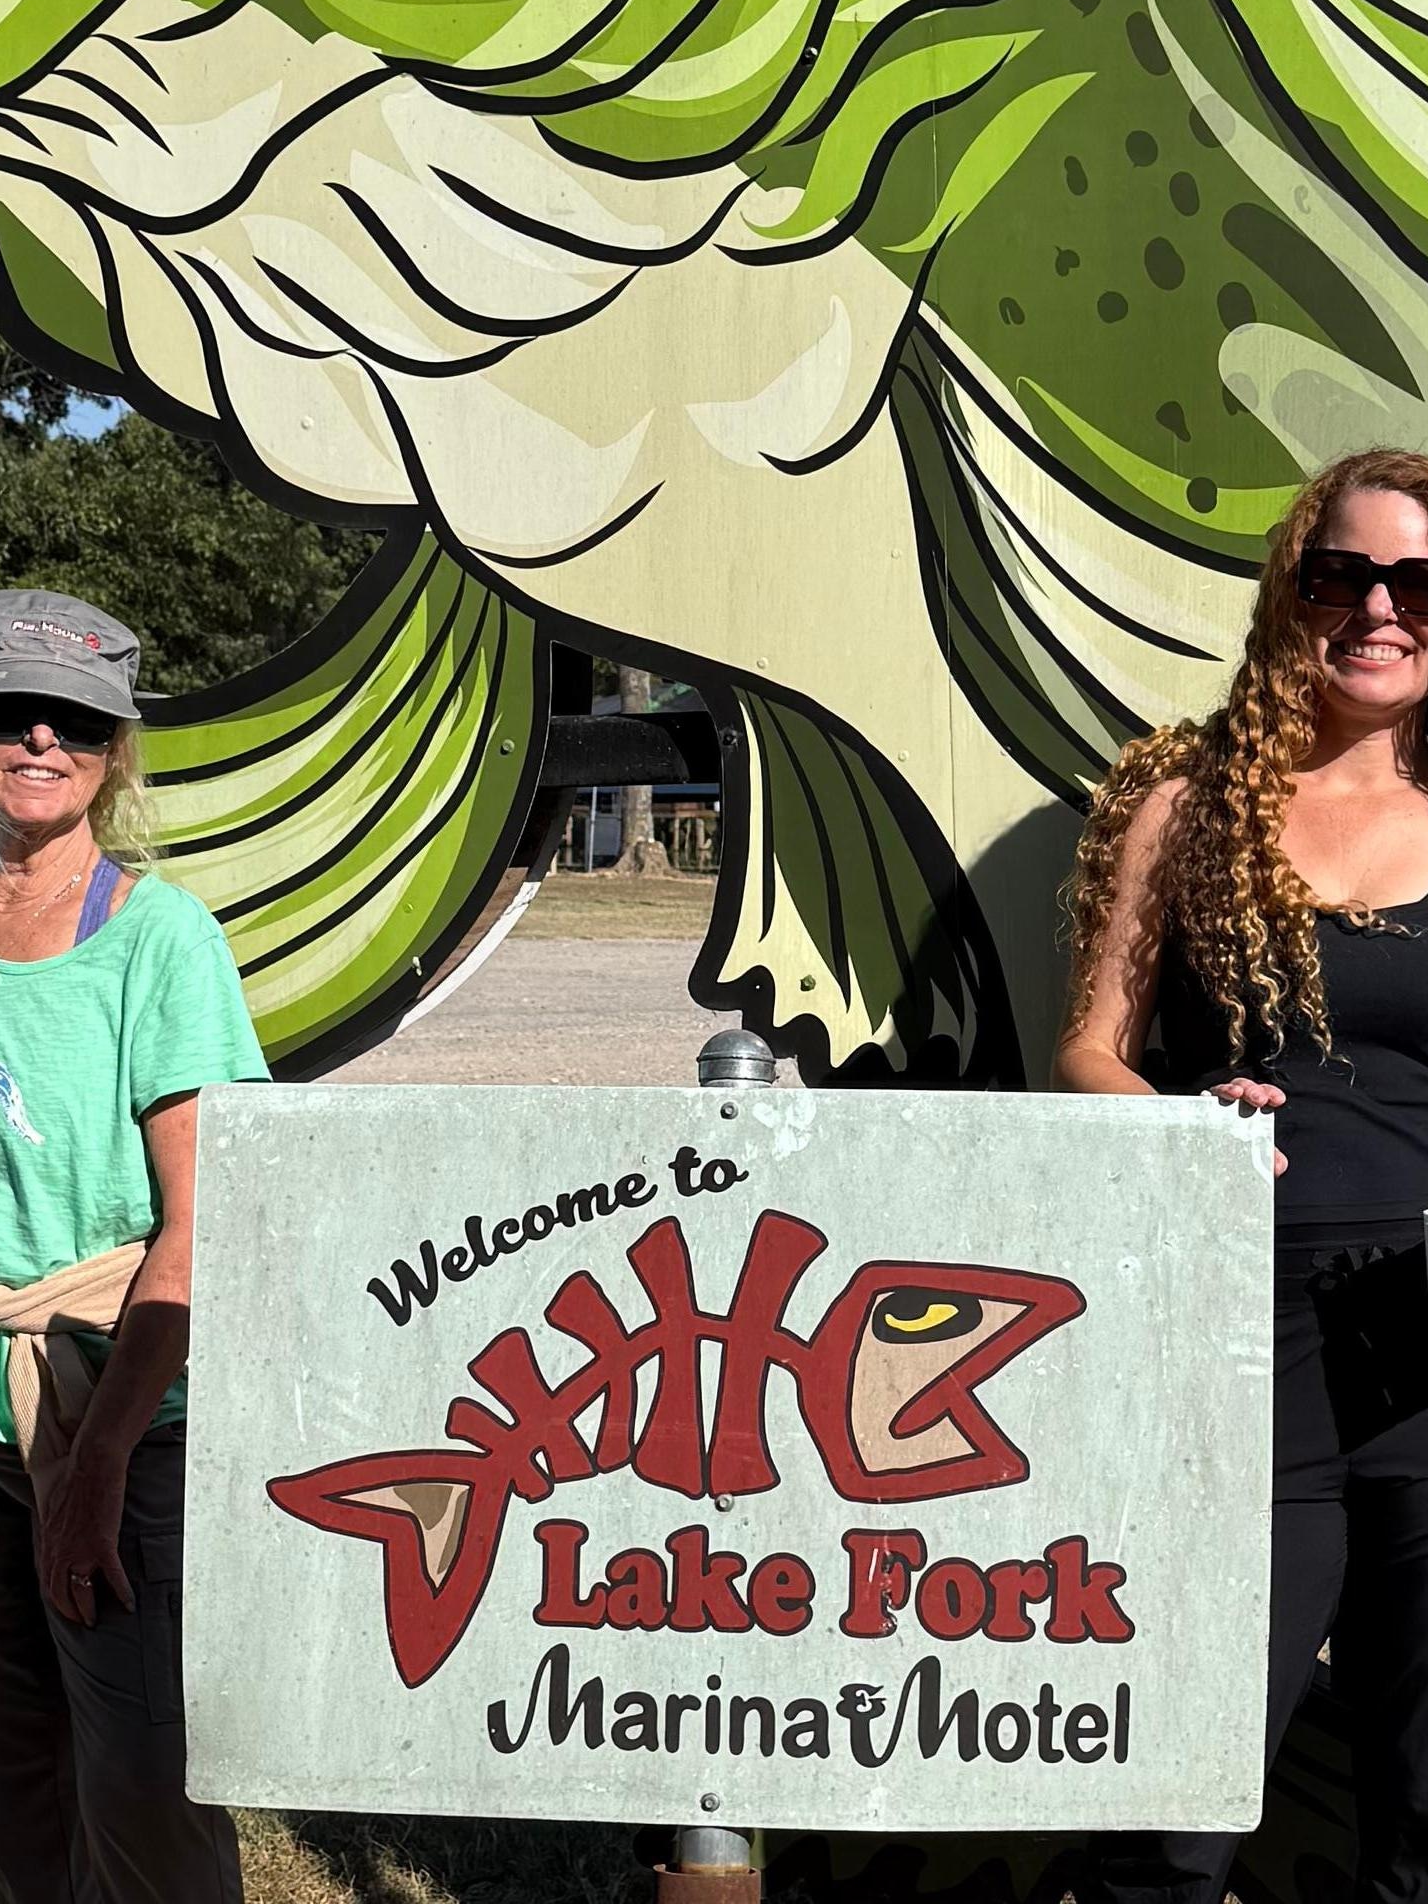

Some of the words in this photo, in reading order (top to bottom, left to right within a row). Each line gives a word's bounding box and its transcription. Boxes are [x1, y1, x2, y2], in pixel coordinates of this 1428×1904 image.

[366, 1172, 658, 1327] Welcome
[667, 1145, 750, 1198] to
[533, 1519, 816, 1636] Lake
[838, 1528, 1135, 1644] Fork
[488, 1643, 831, 1760] Marina
[836, 1655, 1131, 1769] Motel
